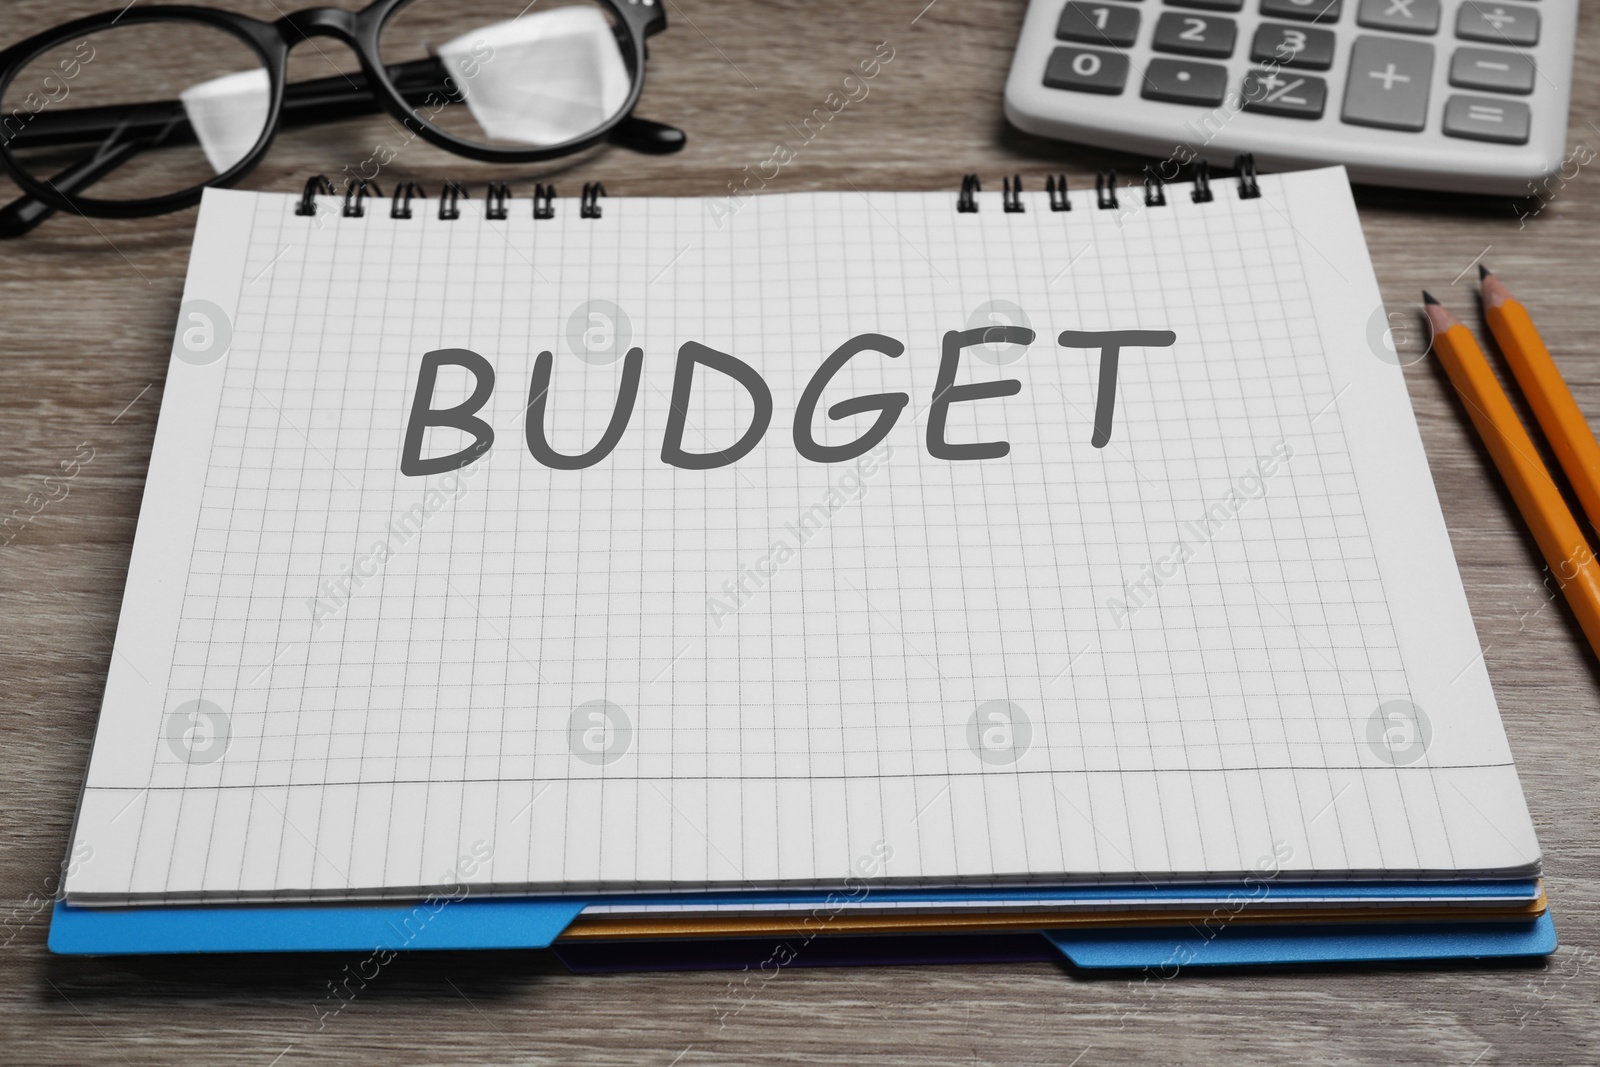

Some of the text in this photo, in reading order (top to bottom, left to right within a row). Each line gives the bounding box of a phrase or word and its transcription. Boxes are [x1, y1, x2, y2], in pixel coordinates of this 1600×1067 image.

[1092, 8, 1110, 30] 1
[1178, 18, 1208, 42] 2
[1281, 29, 1307, 52] 3
[1072, 53, 1102, 76] 0
[401, 327, 1176, 476] BUDGET
